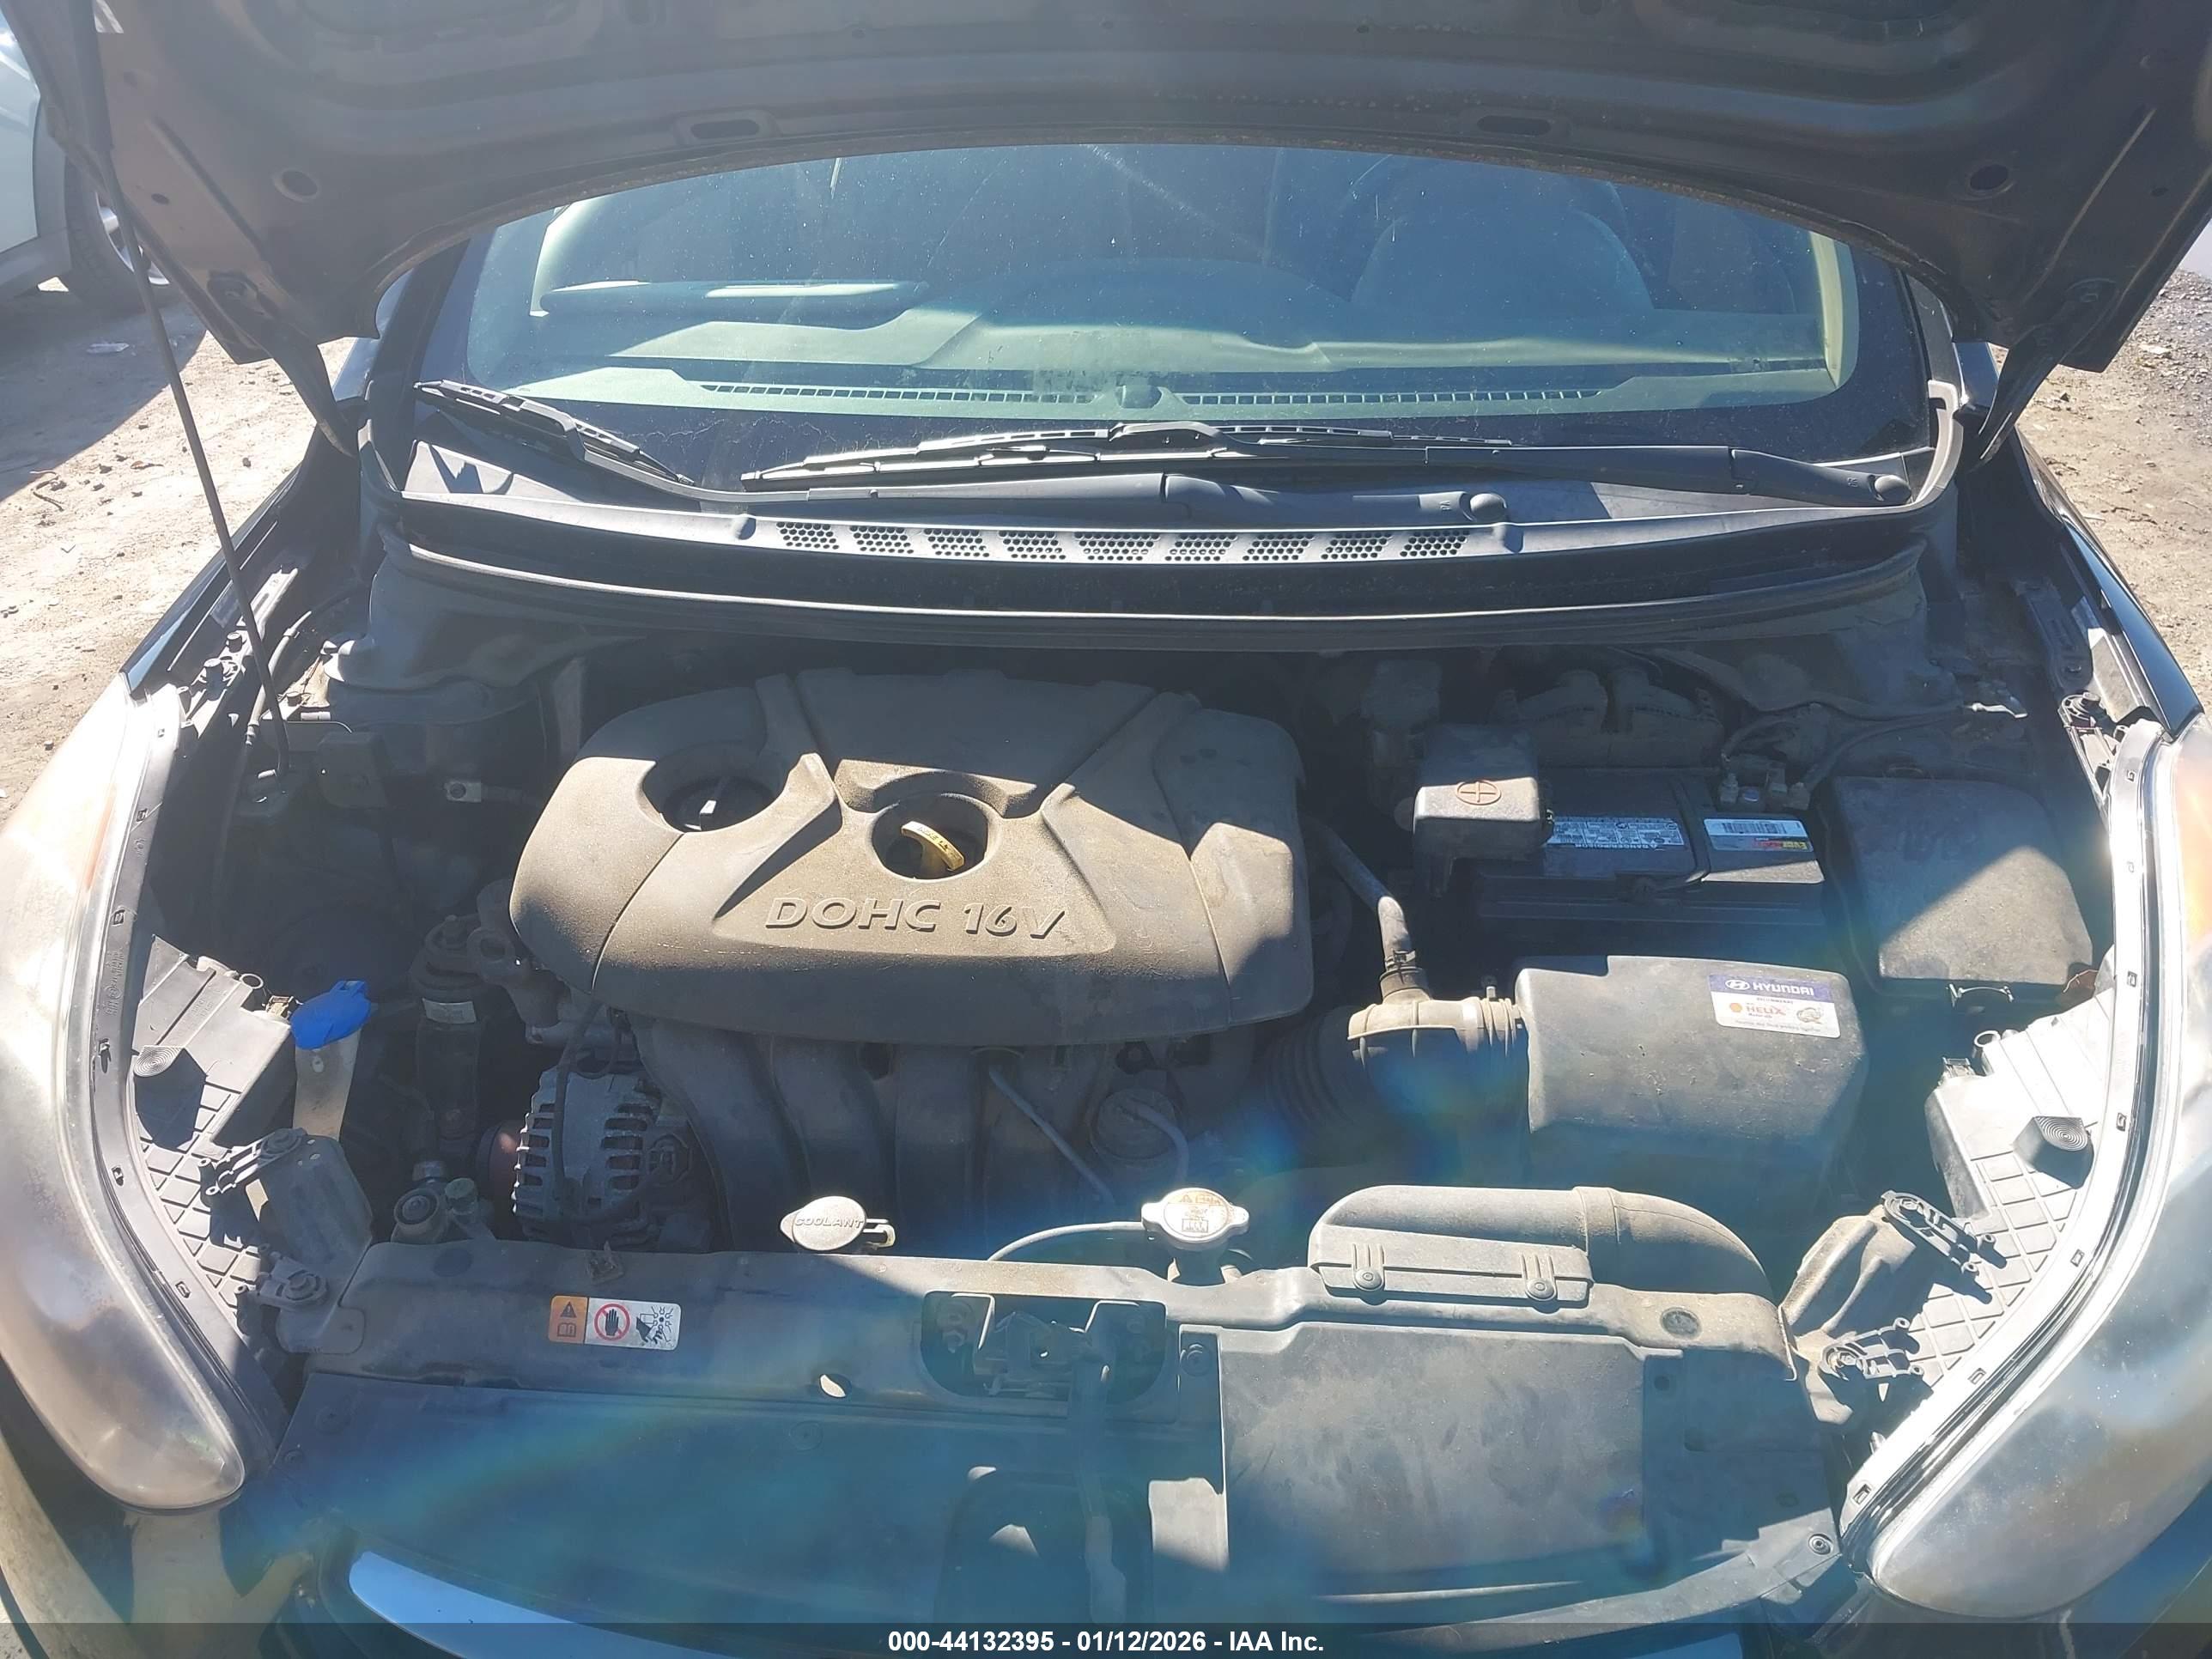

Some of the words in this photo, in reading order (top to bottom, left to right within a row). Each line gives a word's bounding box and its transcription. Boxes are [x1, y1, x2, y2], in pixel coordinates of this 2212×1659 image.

[765, 897, 942, 933] DOHC
[963, 902, 1066, 939] 16V
[1752, 981, 1814, 996] HYUNDAI
[794, 1217, 864, 1228] COOLANT
